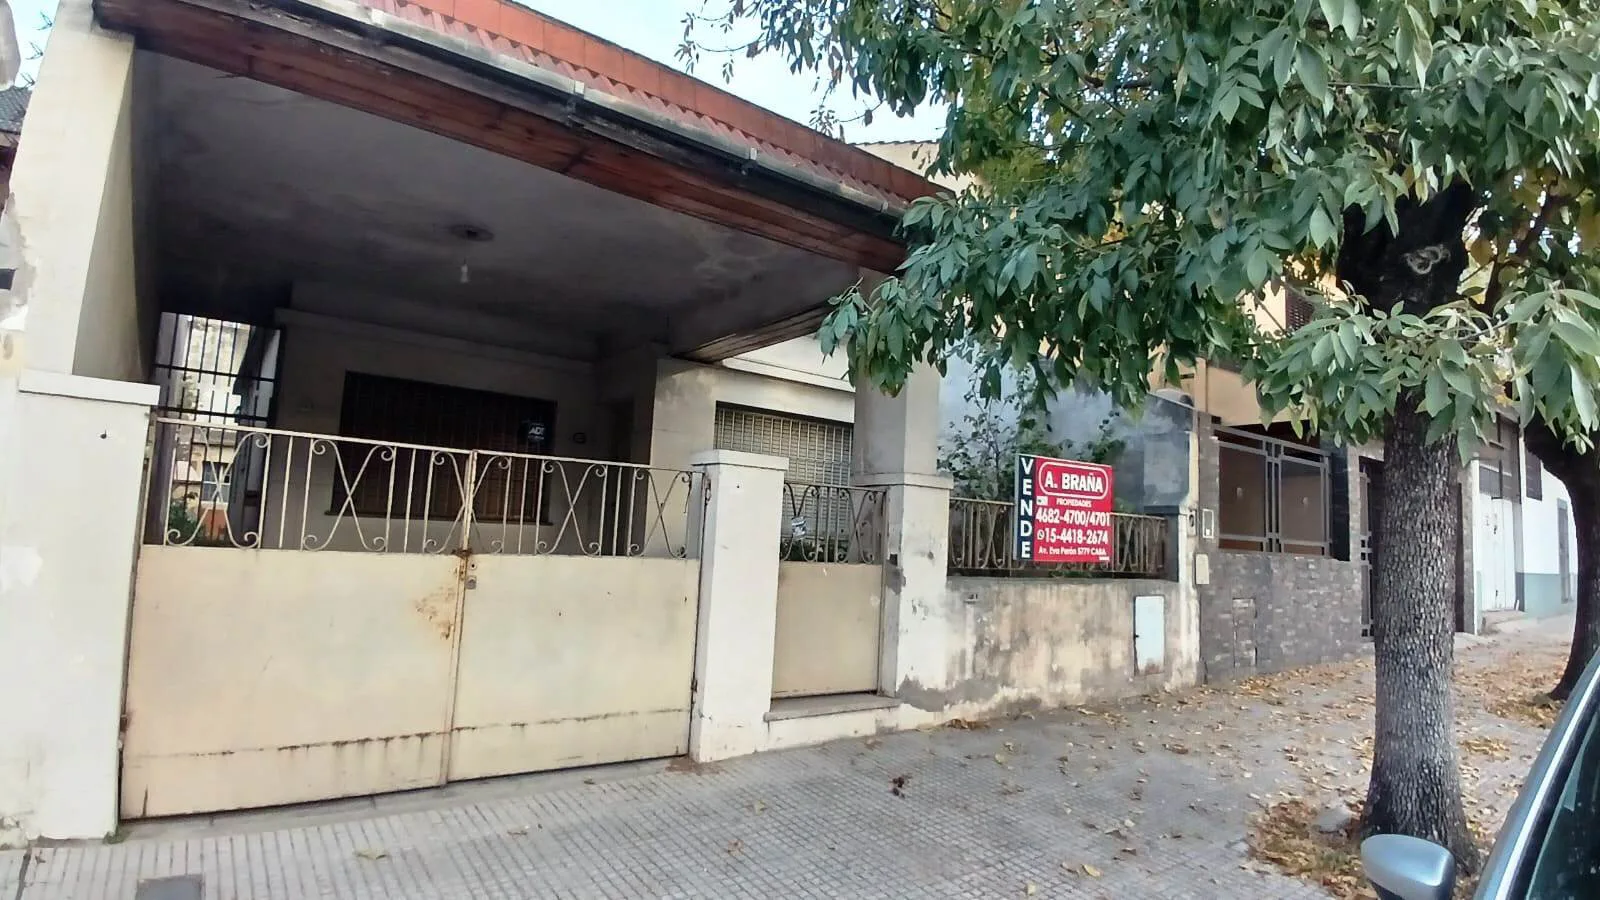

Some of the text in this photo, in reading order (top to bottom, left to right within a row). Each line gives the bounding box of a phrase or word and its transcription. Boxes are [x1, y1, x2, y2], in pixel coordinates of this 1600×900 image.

[1044, 471, 1104, 493] A. BRAÑA
[1020, 457, 1034, 559] VENDE
[1036, 507, 1111, 527] 4682-4700/4701
[1045, 528, 1109, 545] 15-4418-2674
